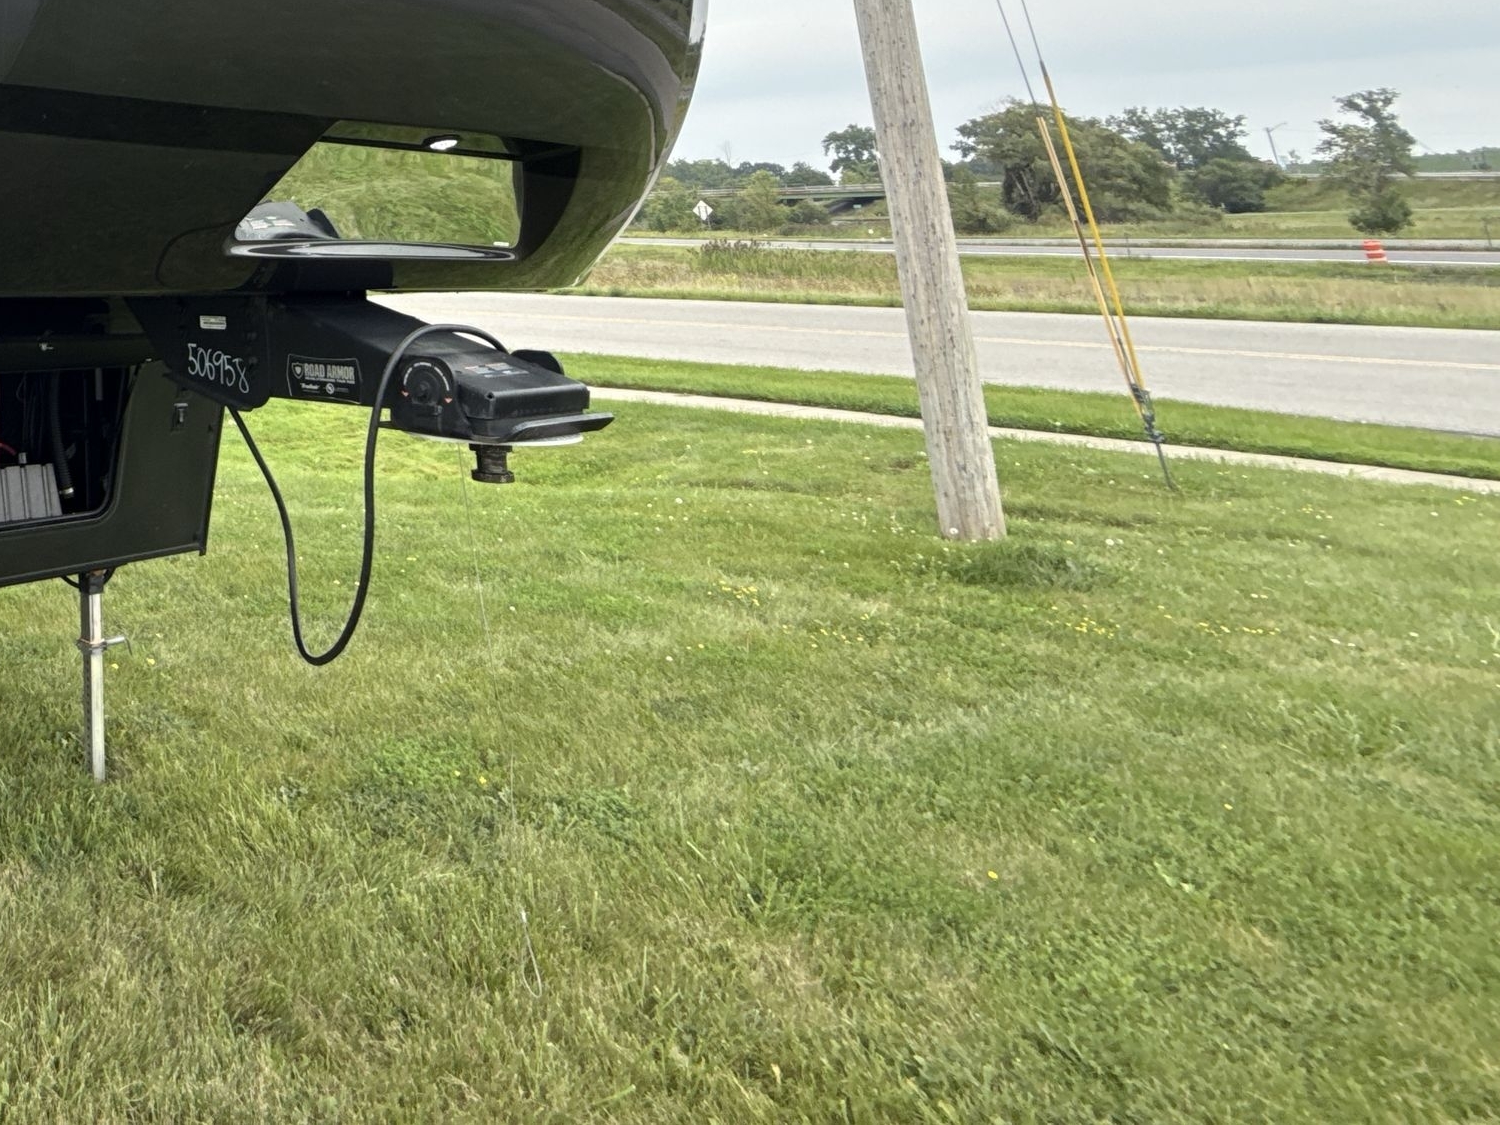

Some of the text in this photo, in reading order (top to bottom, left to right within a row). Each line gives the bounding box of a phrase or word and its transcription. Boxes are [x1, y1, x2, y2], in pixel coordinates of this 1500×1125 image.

[187, 342, 250, 394] 506958
[304, 363, 325, 377] ROAD
[326, 364, 355, 380] ARMOR
